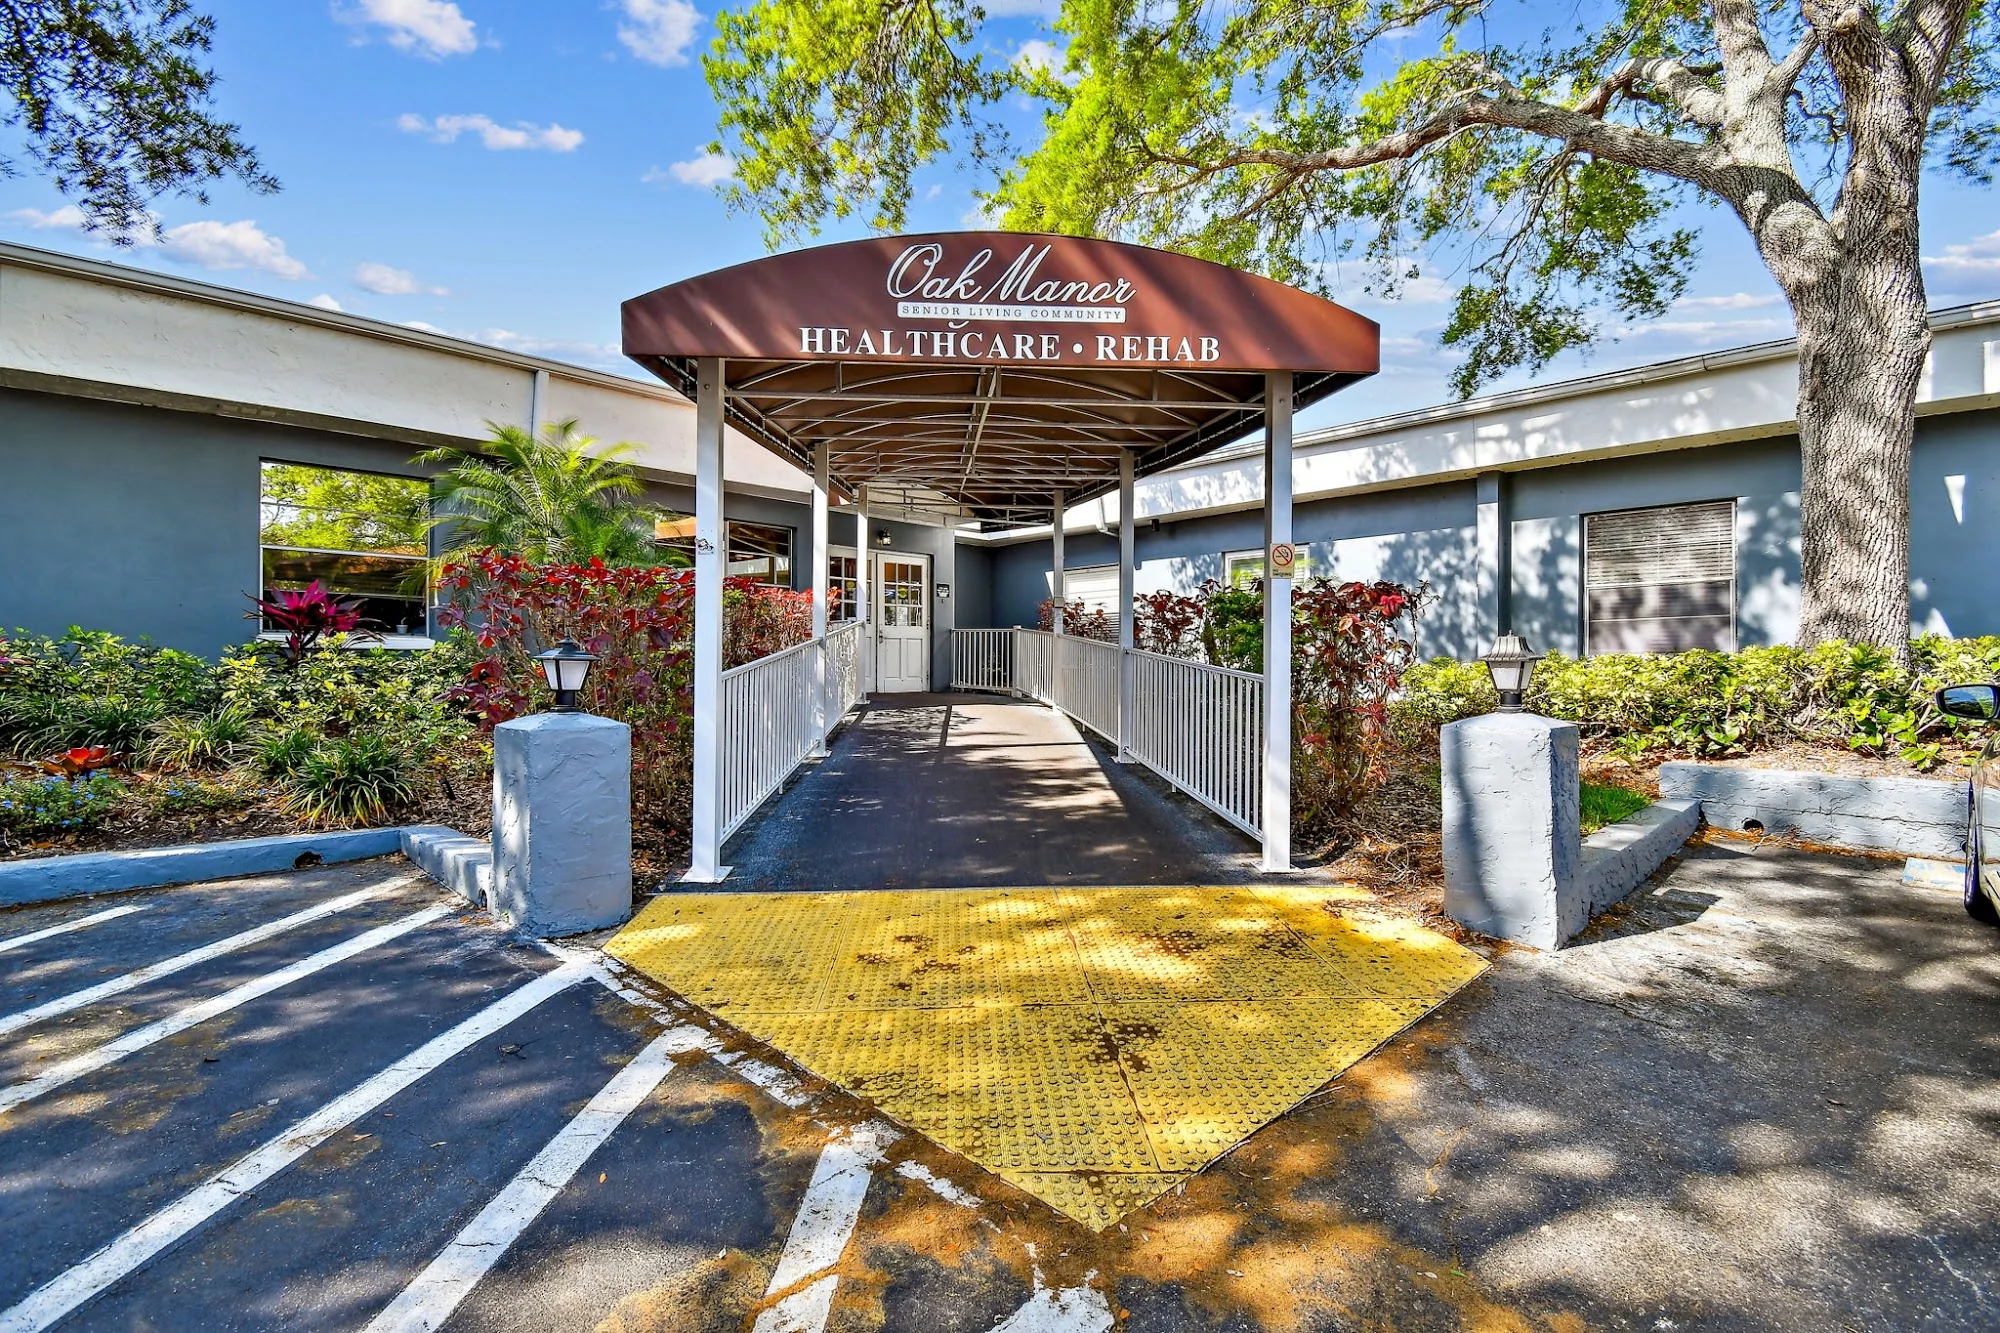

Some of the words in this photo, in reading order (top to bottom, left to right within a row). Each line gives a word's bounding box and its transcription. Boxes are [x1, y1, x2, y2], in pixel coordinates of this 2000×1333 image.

[886, 243, 993, 300] Oak
[979, 243, 1136, 304] Manor
[902, 305, 960, 316] SENIOR
[969, 307, 1022, 318] LIVING
[1030, 309, 1123, 320] COMMUNITY
[798, 326, 1061, 360] HEALTHCARE
[1095, 335, 1221, 362] REHAB
